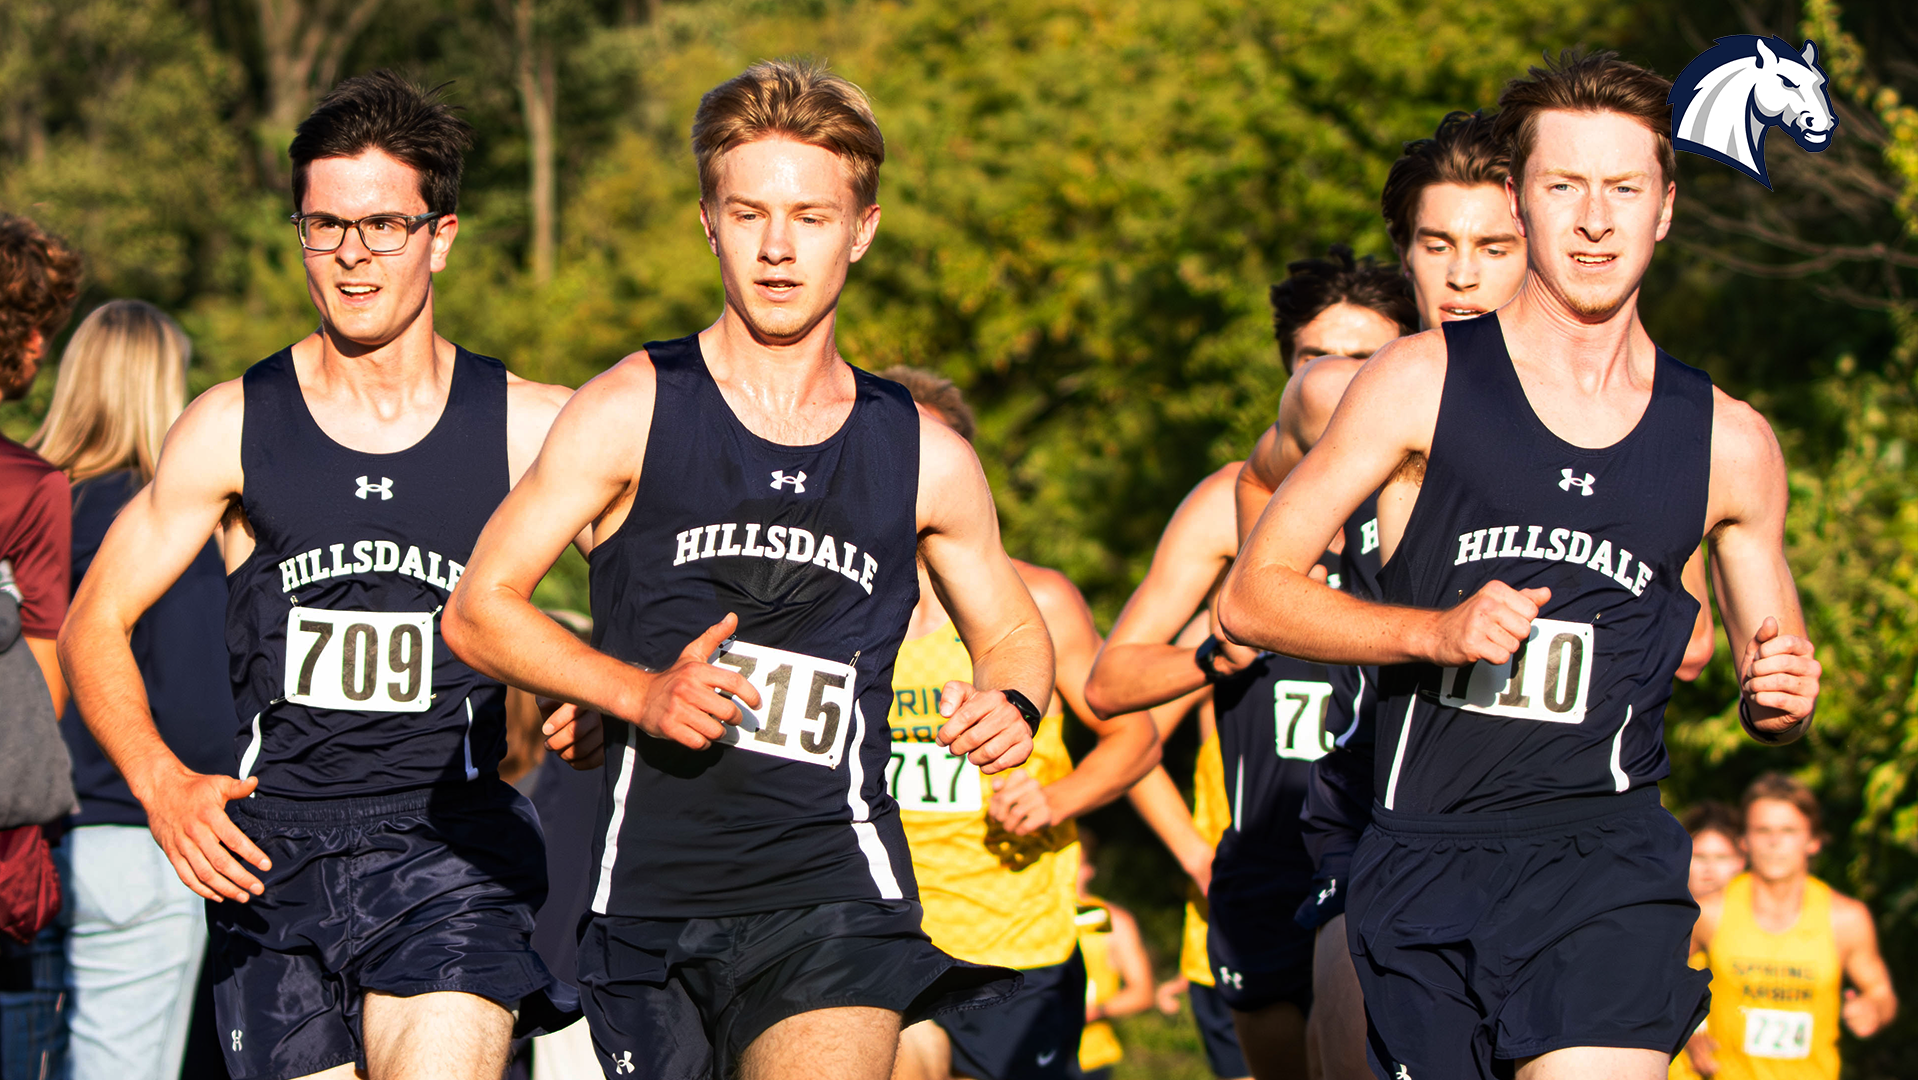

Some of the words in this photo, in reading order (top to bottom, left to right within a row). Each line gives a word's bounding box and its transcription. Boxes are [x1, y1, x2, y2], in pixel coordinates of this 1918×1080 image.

[673, 523, 878, 595] HILLSDALE
[1454, 526, 1654, 597] HILLSDALE
[296, 619, 423, 703] 709
[891, 753, 967, 803] 717
